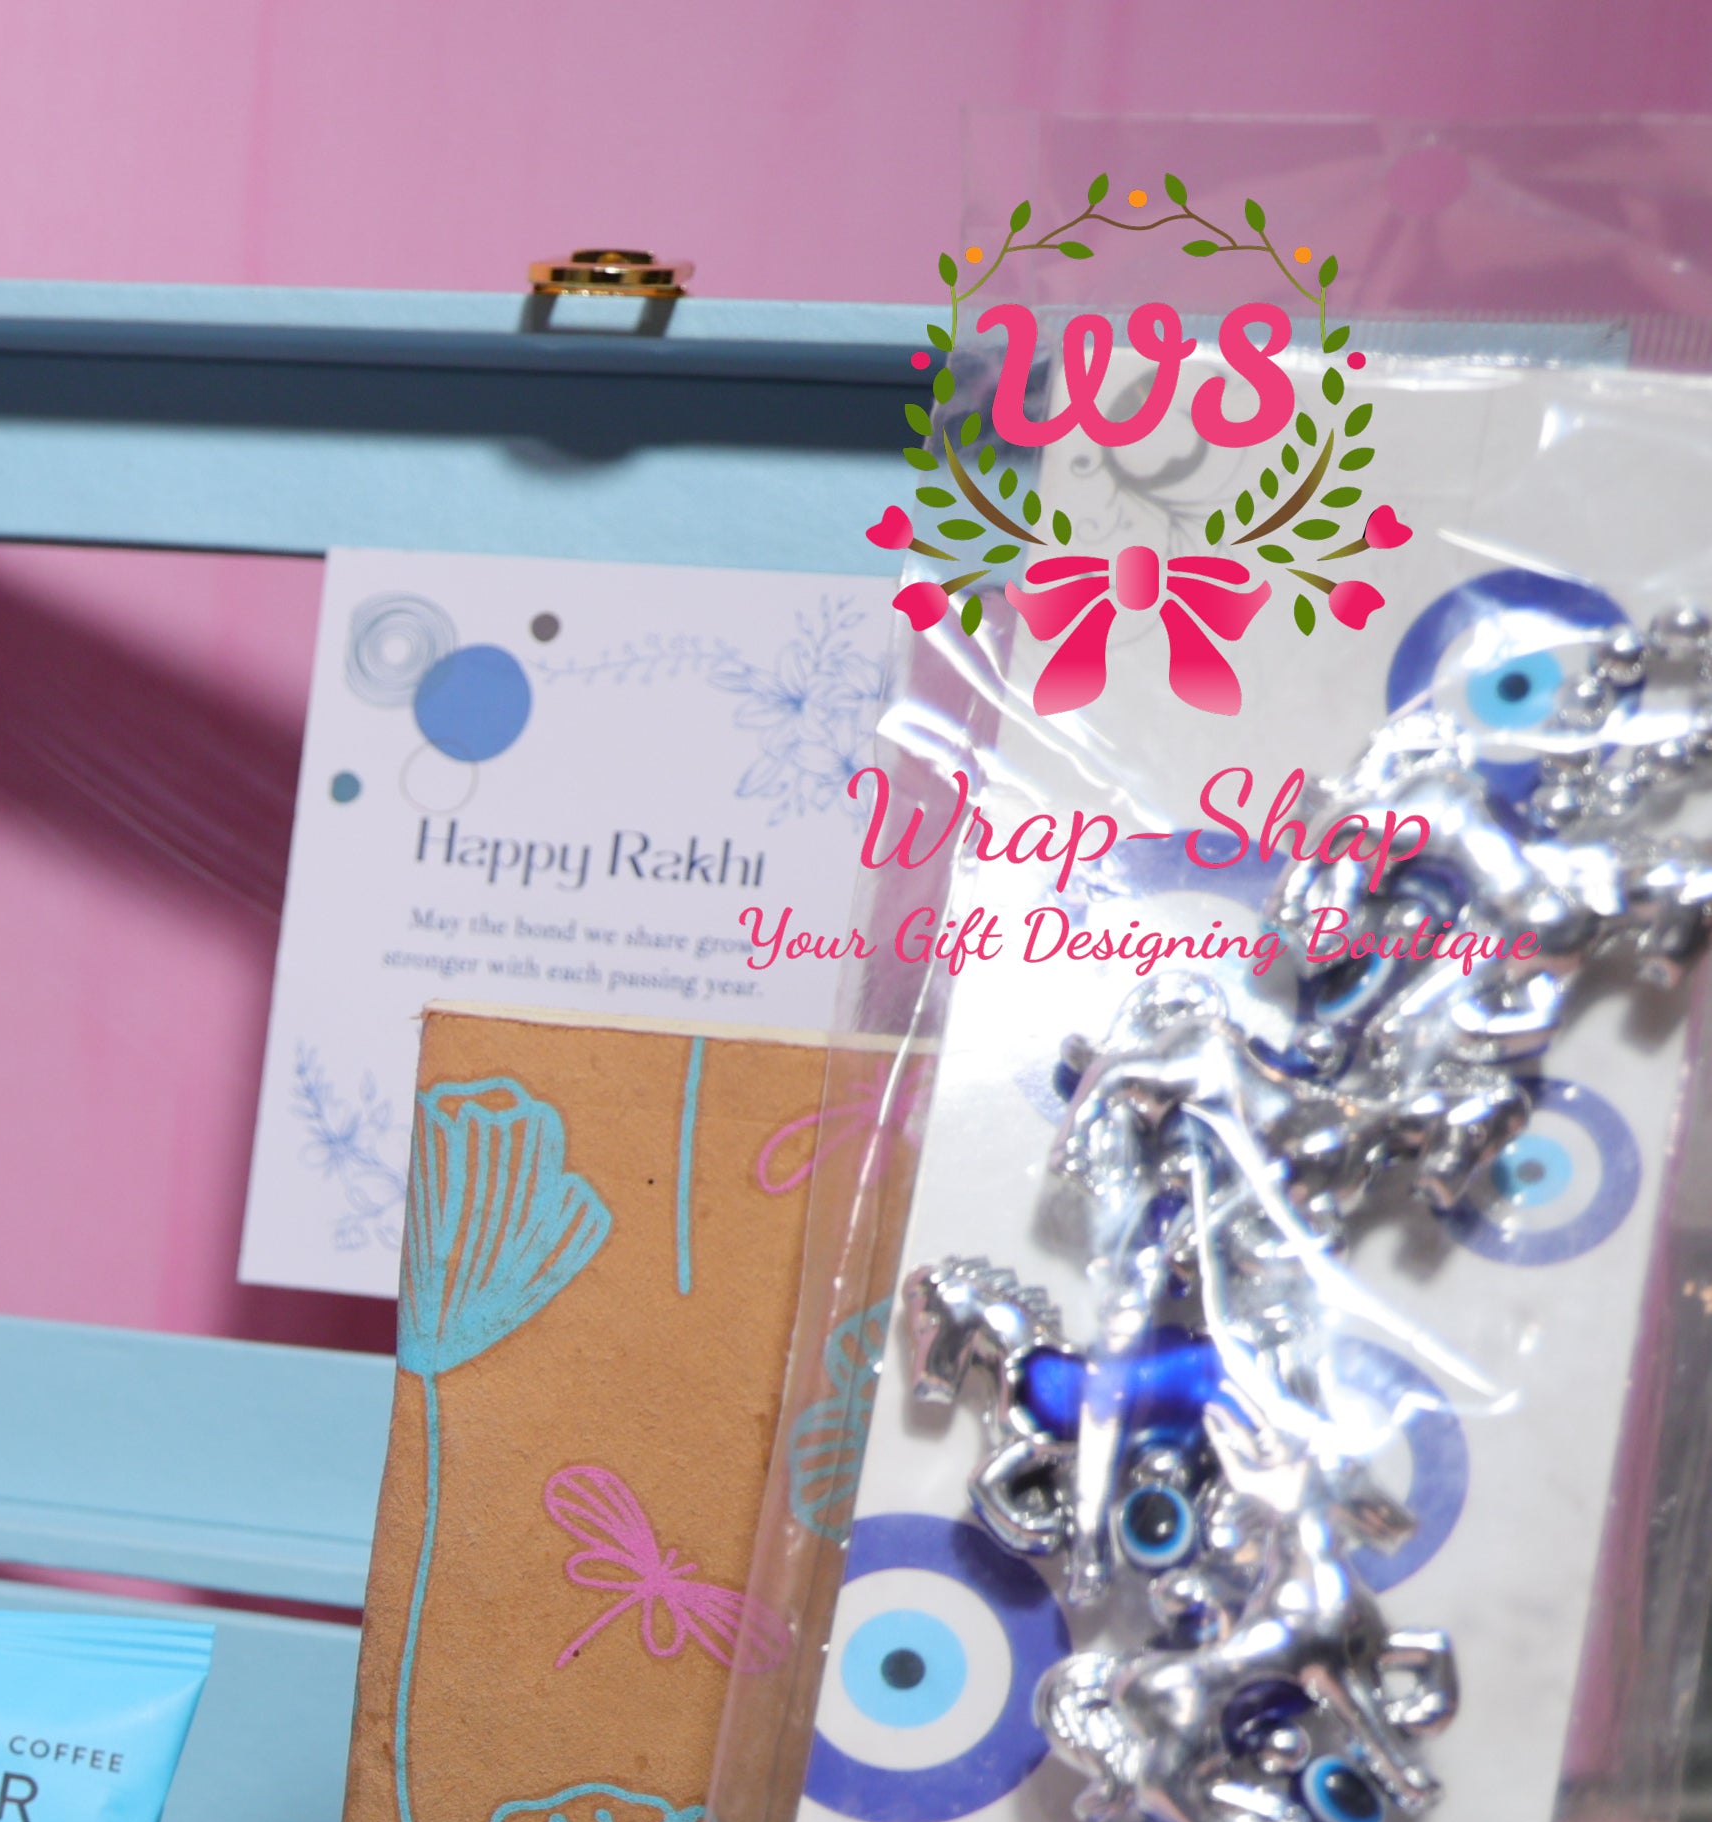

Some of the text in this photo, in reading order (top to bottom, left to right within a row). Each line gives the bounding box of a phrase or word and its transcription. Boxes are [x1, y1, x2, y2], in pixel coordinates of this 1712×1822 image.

[415, 815, 766, 891] Happy Rakhi
[408, 907, 460, 938] May
[469, 912, 507, 939] the
[514, 916, 577, 942] bond
[583, 928, 619, 947] we
[624, 924, 690, 952] share
[382, 950, 765, 1002] stronger with each passing year.
[7, 1734, 126, 1775] COFFEE
